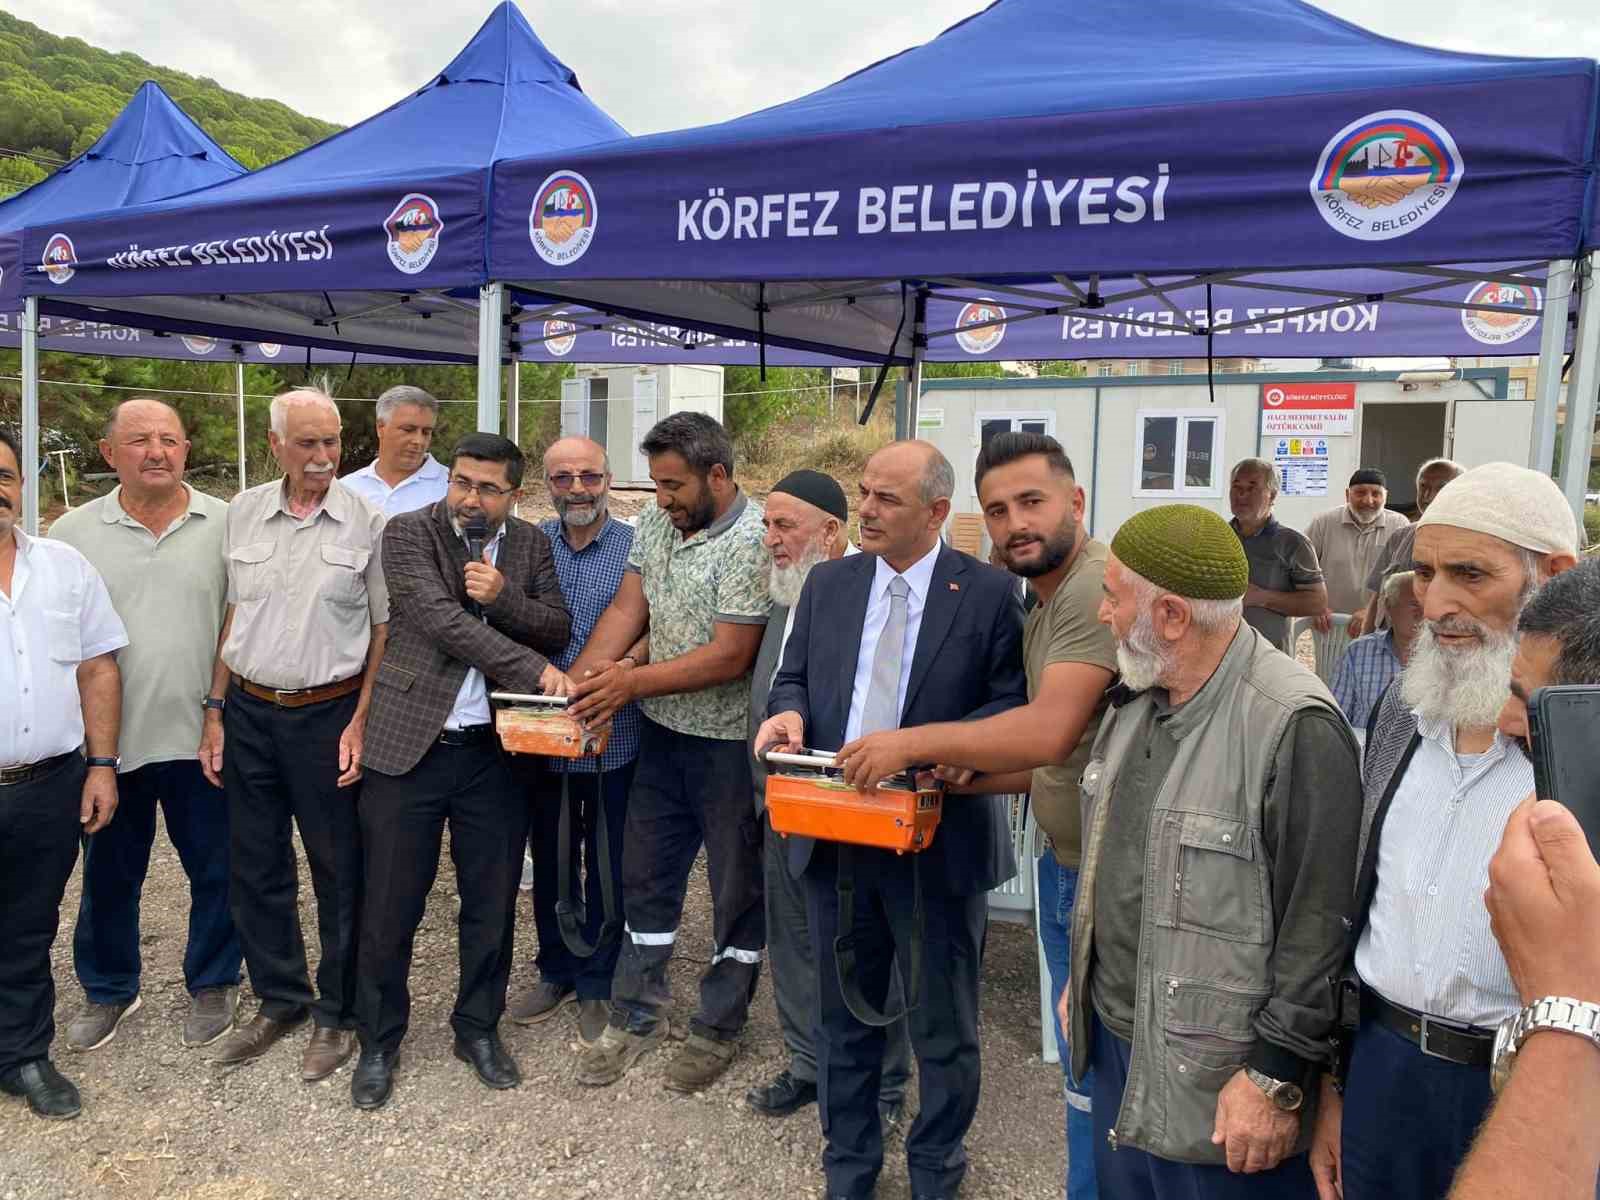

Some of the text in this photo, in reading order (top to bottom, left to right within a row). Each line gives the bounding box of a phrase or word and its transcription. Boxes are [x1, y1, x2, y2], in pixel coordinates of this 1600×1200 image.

[678, 163, 1169, 241] KÖRFEZ BELEDİYESİ
[1322, 184, 1449, 232] KÖRFEZ BELEDİYESİ
